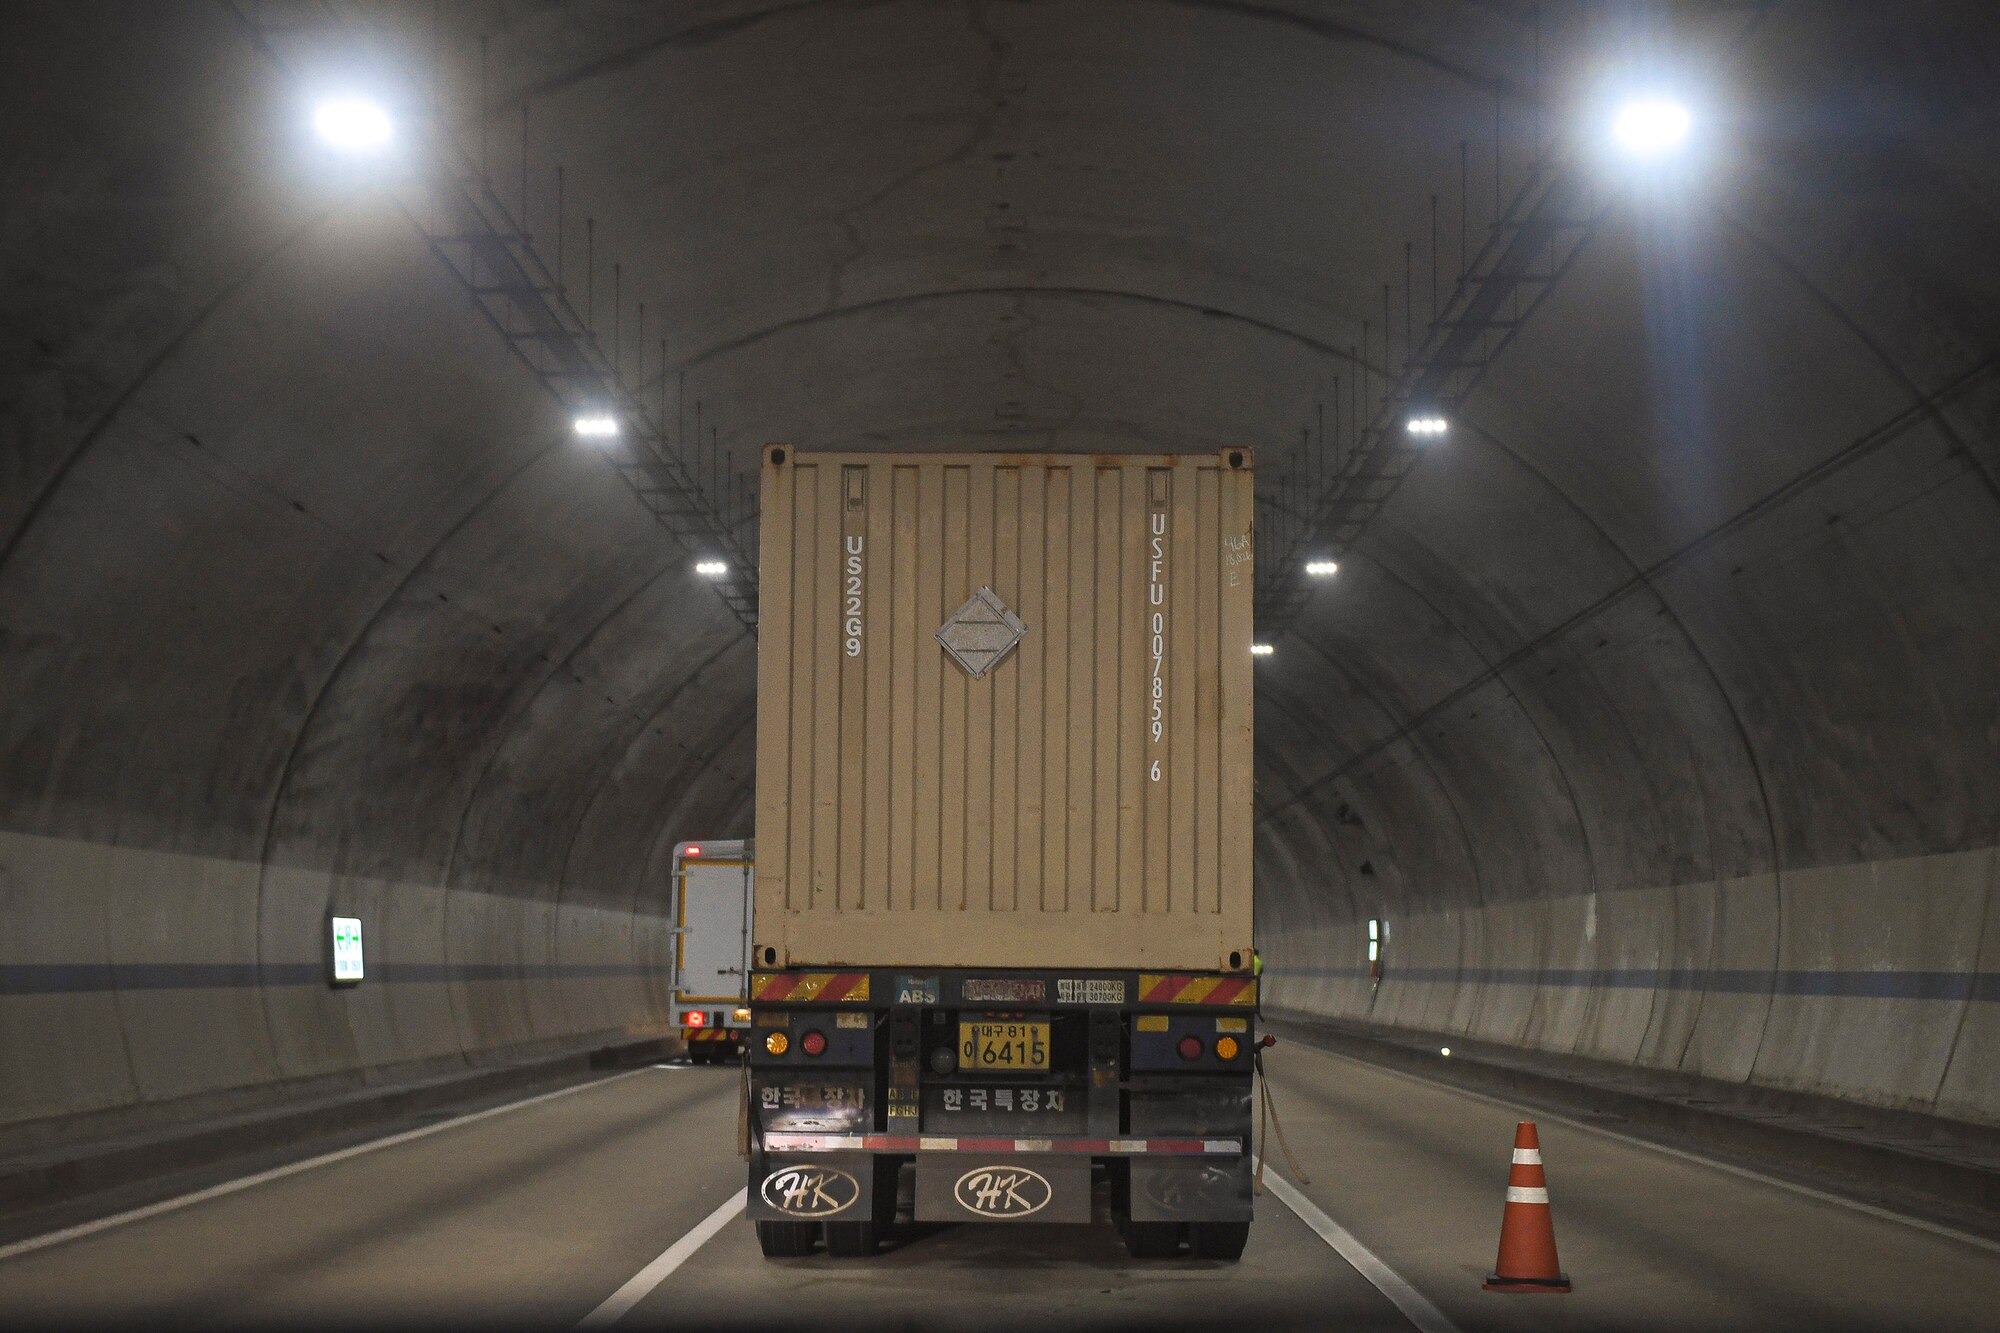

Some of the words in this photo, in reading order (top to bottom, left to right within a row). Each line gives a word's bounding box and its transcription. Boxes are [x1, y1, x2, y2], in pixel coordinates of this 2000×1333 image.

[1150, 513, 1165, 605] USFU
[845, 536, 863, 657] US22G9
[1151, 612, 1163, 742] 007859
[1150, 760, 1161, 782] 6
[899, 990, 936, 1004] ABS
[982, 1025, 1003, 1037] 대구
[1008, 1025, 1026, 1038] 81
[982, 1041, 1045, 1065] 6415
[761, 1086, 866, 1110] 한국장차
[775, 1172, 839, 1209] HK
[968, 1173, 1031, 1210] HK
